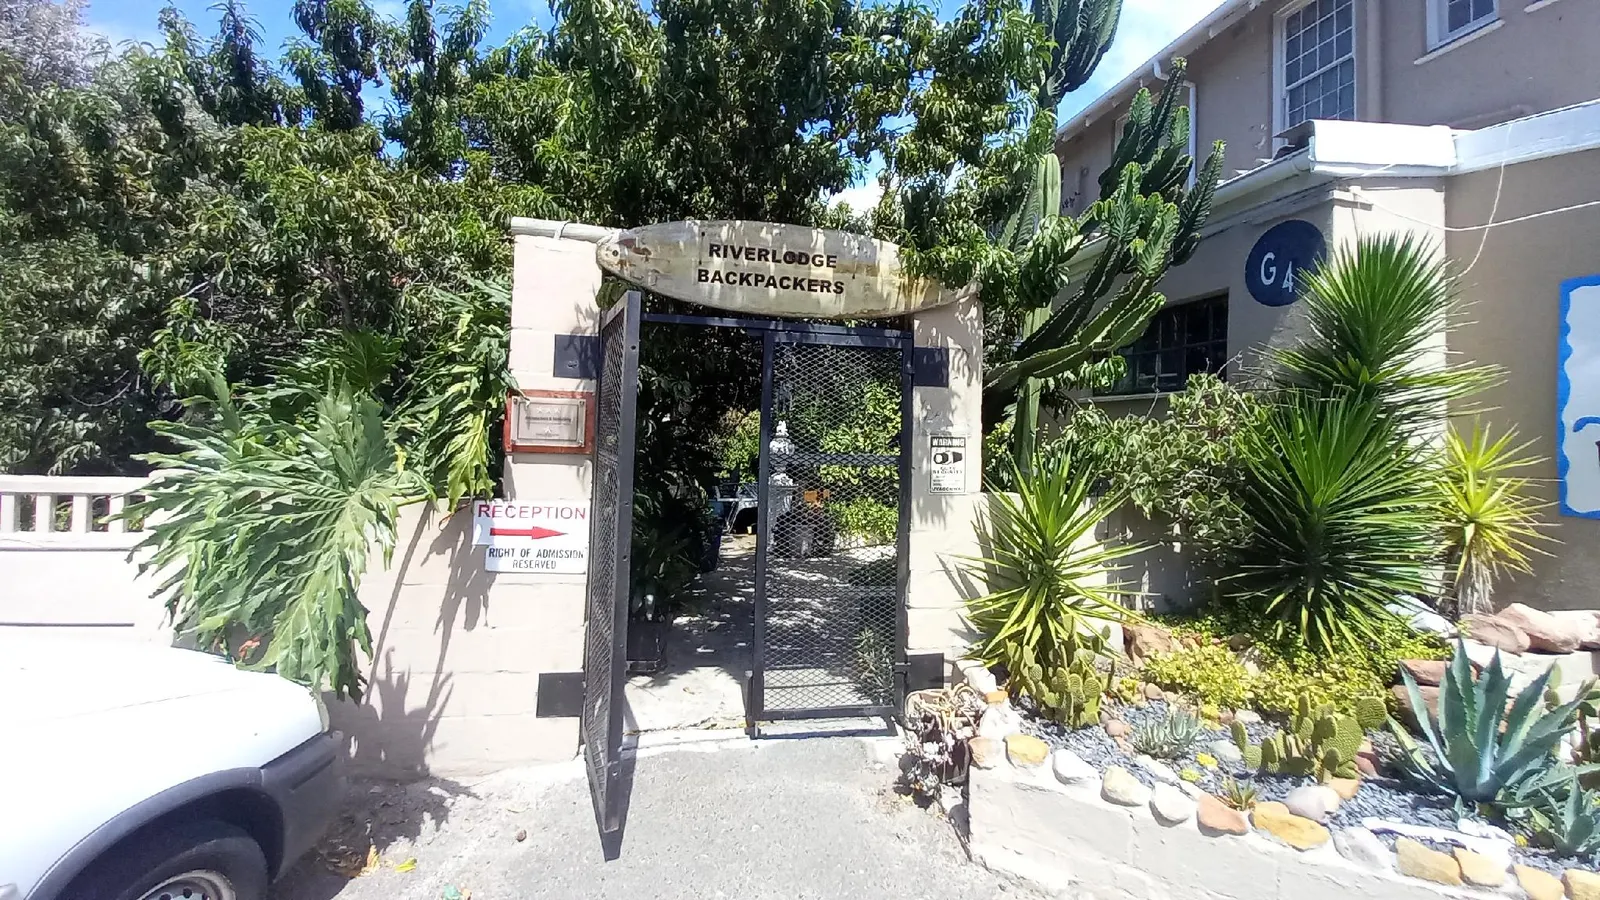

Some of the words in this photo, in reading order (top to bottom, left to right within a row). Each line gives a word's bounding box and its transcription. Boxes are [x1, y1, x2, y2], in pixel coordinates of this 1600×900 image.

[709, 243, 838, 269] RIVERLODGE
[697, 268, 845, 295] BACKPACKERS
[478, 504, 586, 520] RECEPTION
[488, 547, 515, 558] RIGHT
[520, 548, 531, 558] OF
[536, 549, 584, 559] ADMISSION
[512, 559, 557, 570] RESERVED
